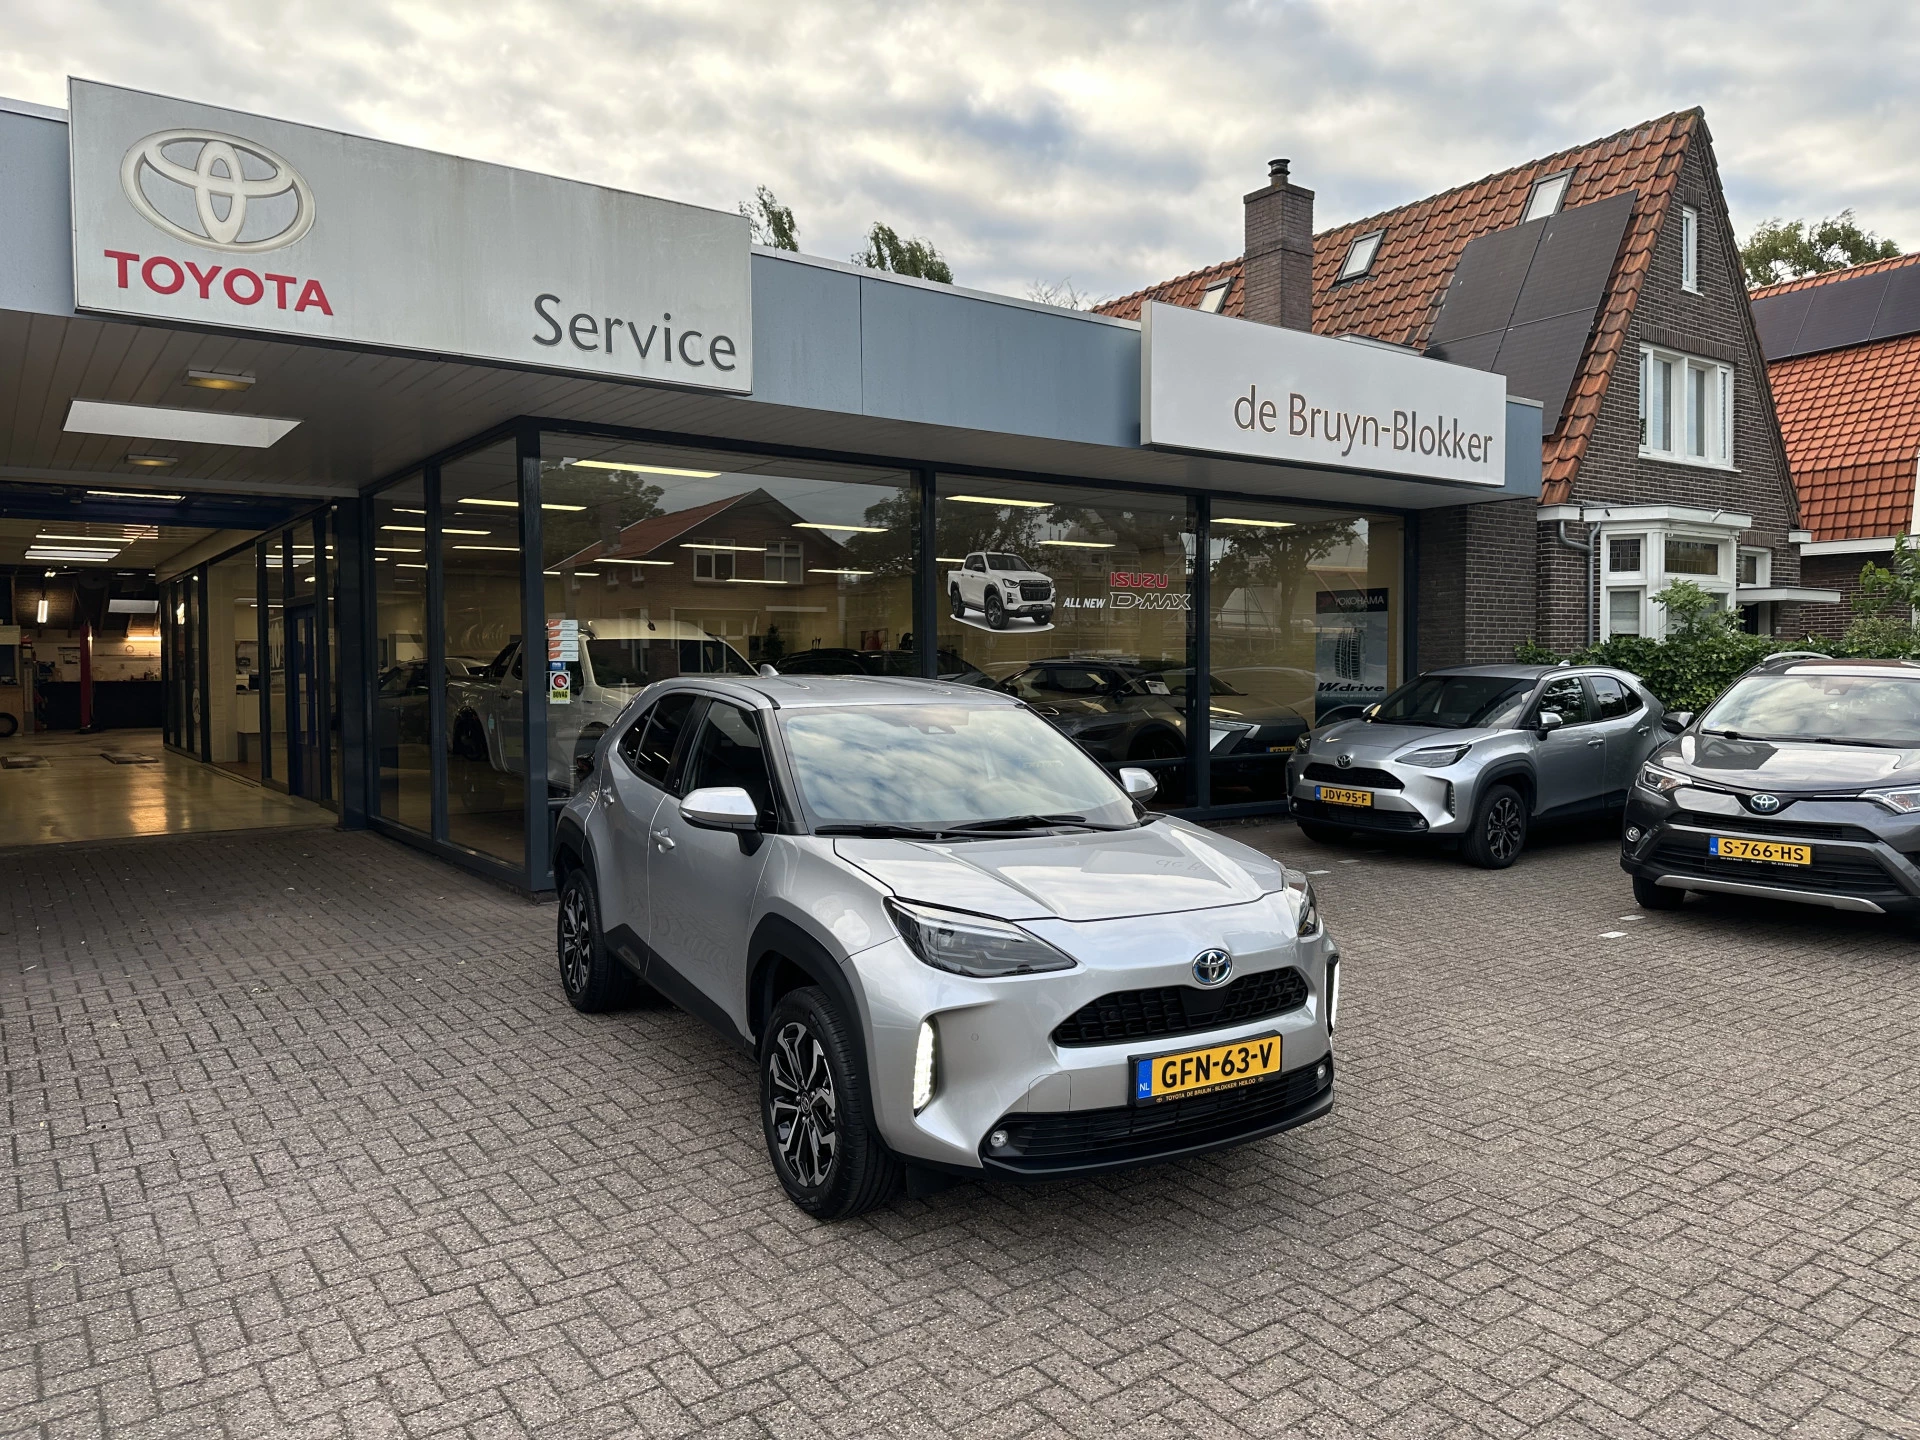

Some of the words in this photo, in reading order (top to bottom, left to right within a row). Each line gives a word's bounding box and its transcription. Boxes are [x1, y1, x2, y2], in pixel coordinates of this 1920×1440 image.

[104, 250, 333, 316] TOYOTA
[532, 292, 737, 372] Service
[1233, 383, 1277, 433] de
[1288, 392, 1494, 464] Bruyn-Blokker
[1110, 571, 1168, 588] ISUZU
[1063, 597, 1081, 608] ALL
[1083, 598, 1106, 608] NEW
[1335, 595, 1385, 606] YOKOHAMA
[1323, 789, 1367, 804] JDV-95-F
[1723, 841, 1804, 861] S-766-HS
[1161, 1042, 1273, 1088] GFN-63-V
[1139, 1082, 1150, 1092] NL
[1166, 1093, 1185, 1101] TOYOTA
[1214, 1081, 1237, 1092] BLOKKER
